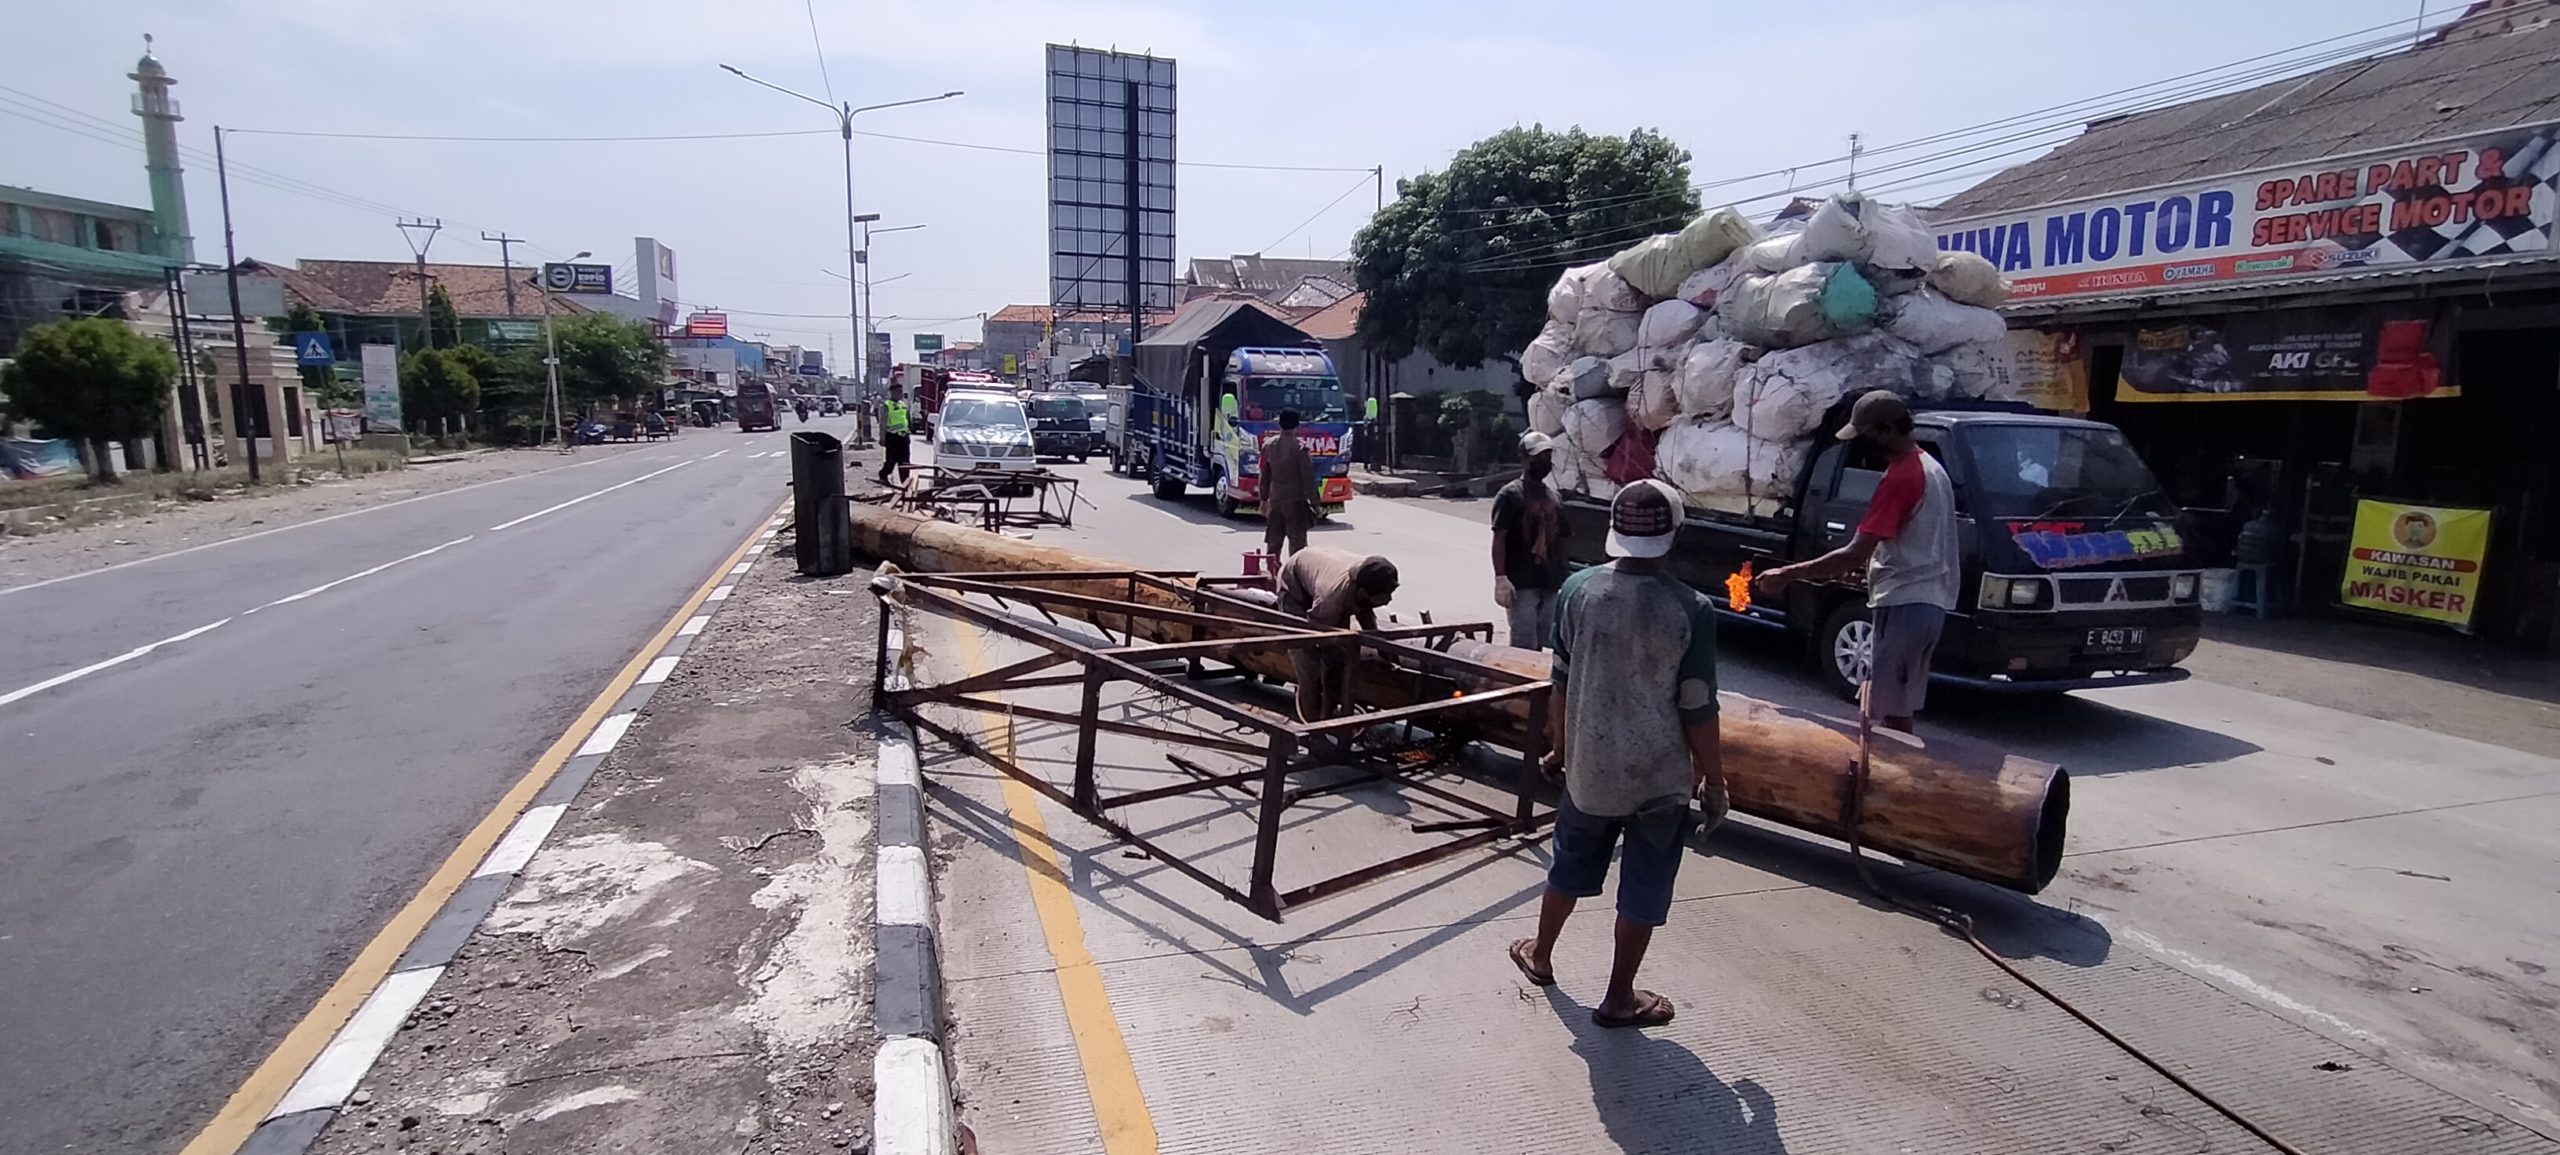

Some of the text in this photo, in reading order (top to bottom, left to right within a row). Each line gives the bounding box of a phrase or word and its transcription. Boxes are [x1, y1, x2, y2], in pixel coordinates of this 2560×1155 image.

[2255, 148, 2503, 211] SPARE PART &
[2251, 186, 2532, 247] SERVICE MOTOR
[2044, 190, 2234, 267] MOTOR
[2328, 249, 2379, 262] SUZUKI
[2092, 271, 2147, 287] HONDA
[2175, 264, 2215, 278] YAMAHA
[2012, 282, 2046, 294] amayu
[2268, 352, 2310, 369] AKI
[2370, 550, 2455, 570] KAWASAN
[2362, 565, 2460, 586] WAJIB PAKAI
[2350, 580, 2466, 613] MASKER
[2087, 630, 2095, 645] E
